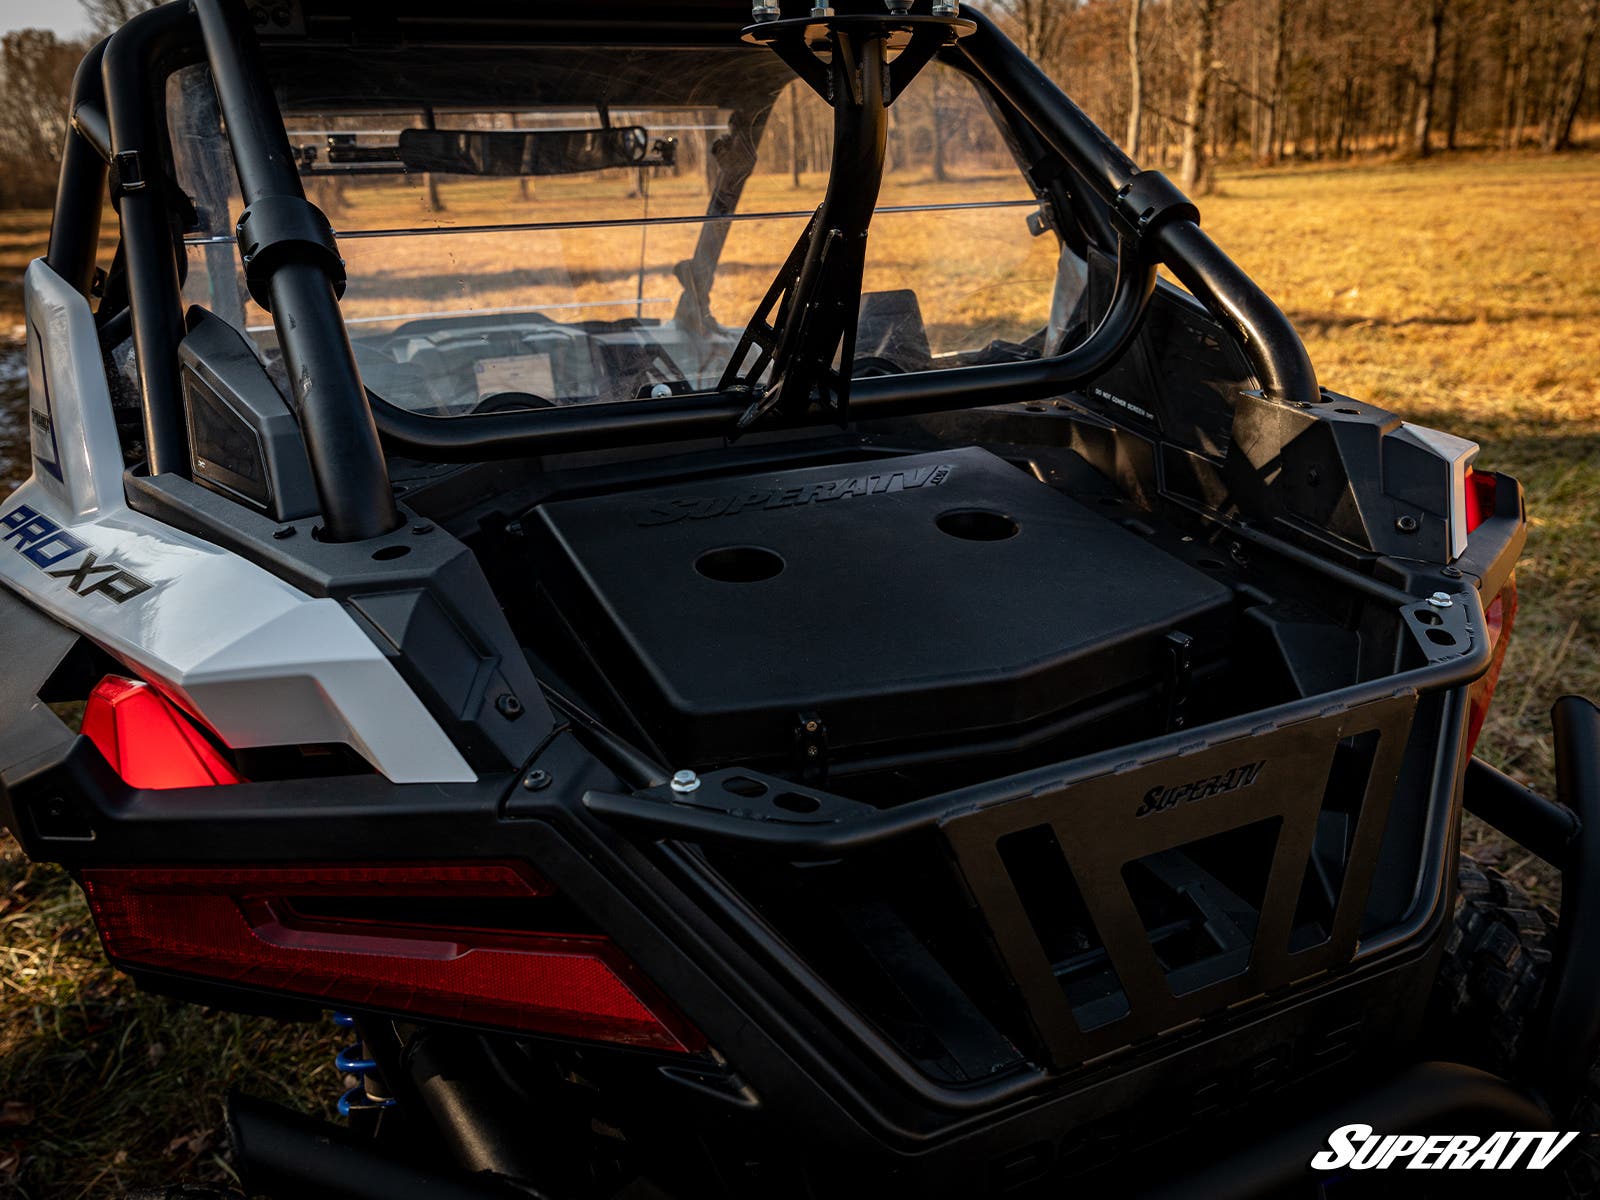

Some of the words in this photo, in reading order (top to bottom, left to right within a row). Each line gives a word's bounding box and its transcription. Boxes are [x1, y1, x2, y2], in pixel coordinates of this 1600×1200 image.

[1112, 396, 1127, 408] COVER
[0, 504, 89, 570] PRO
[47, 551, 154, 605] XP
